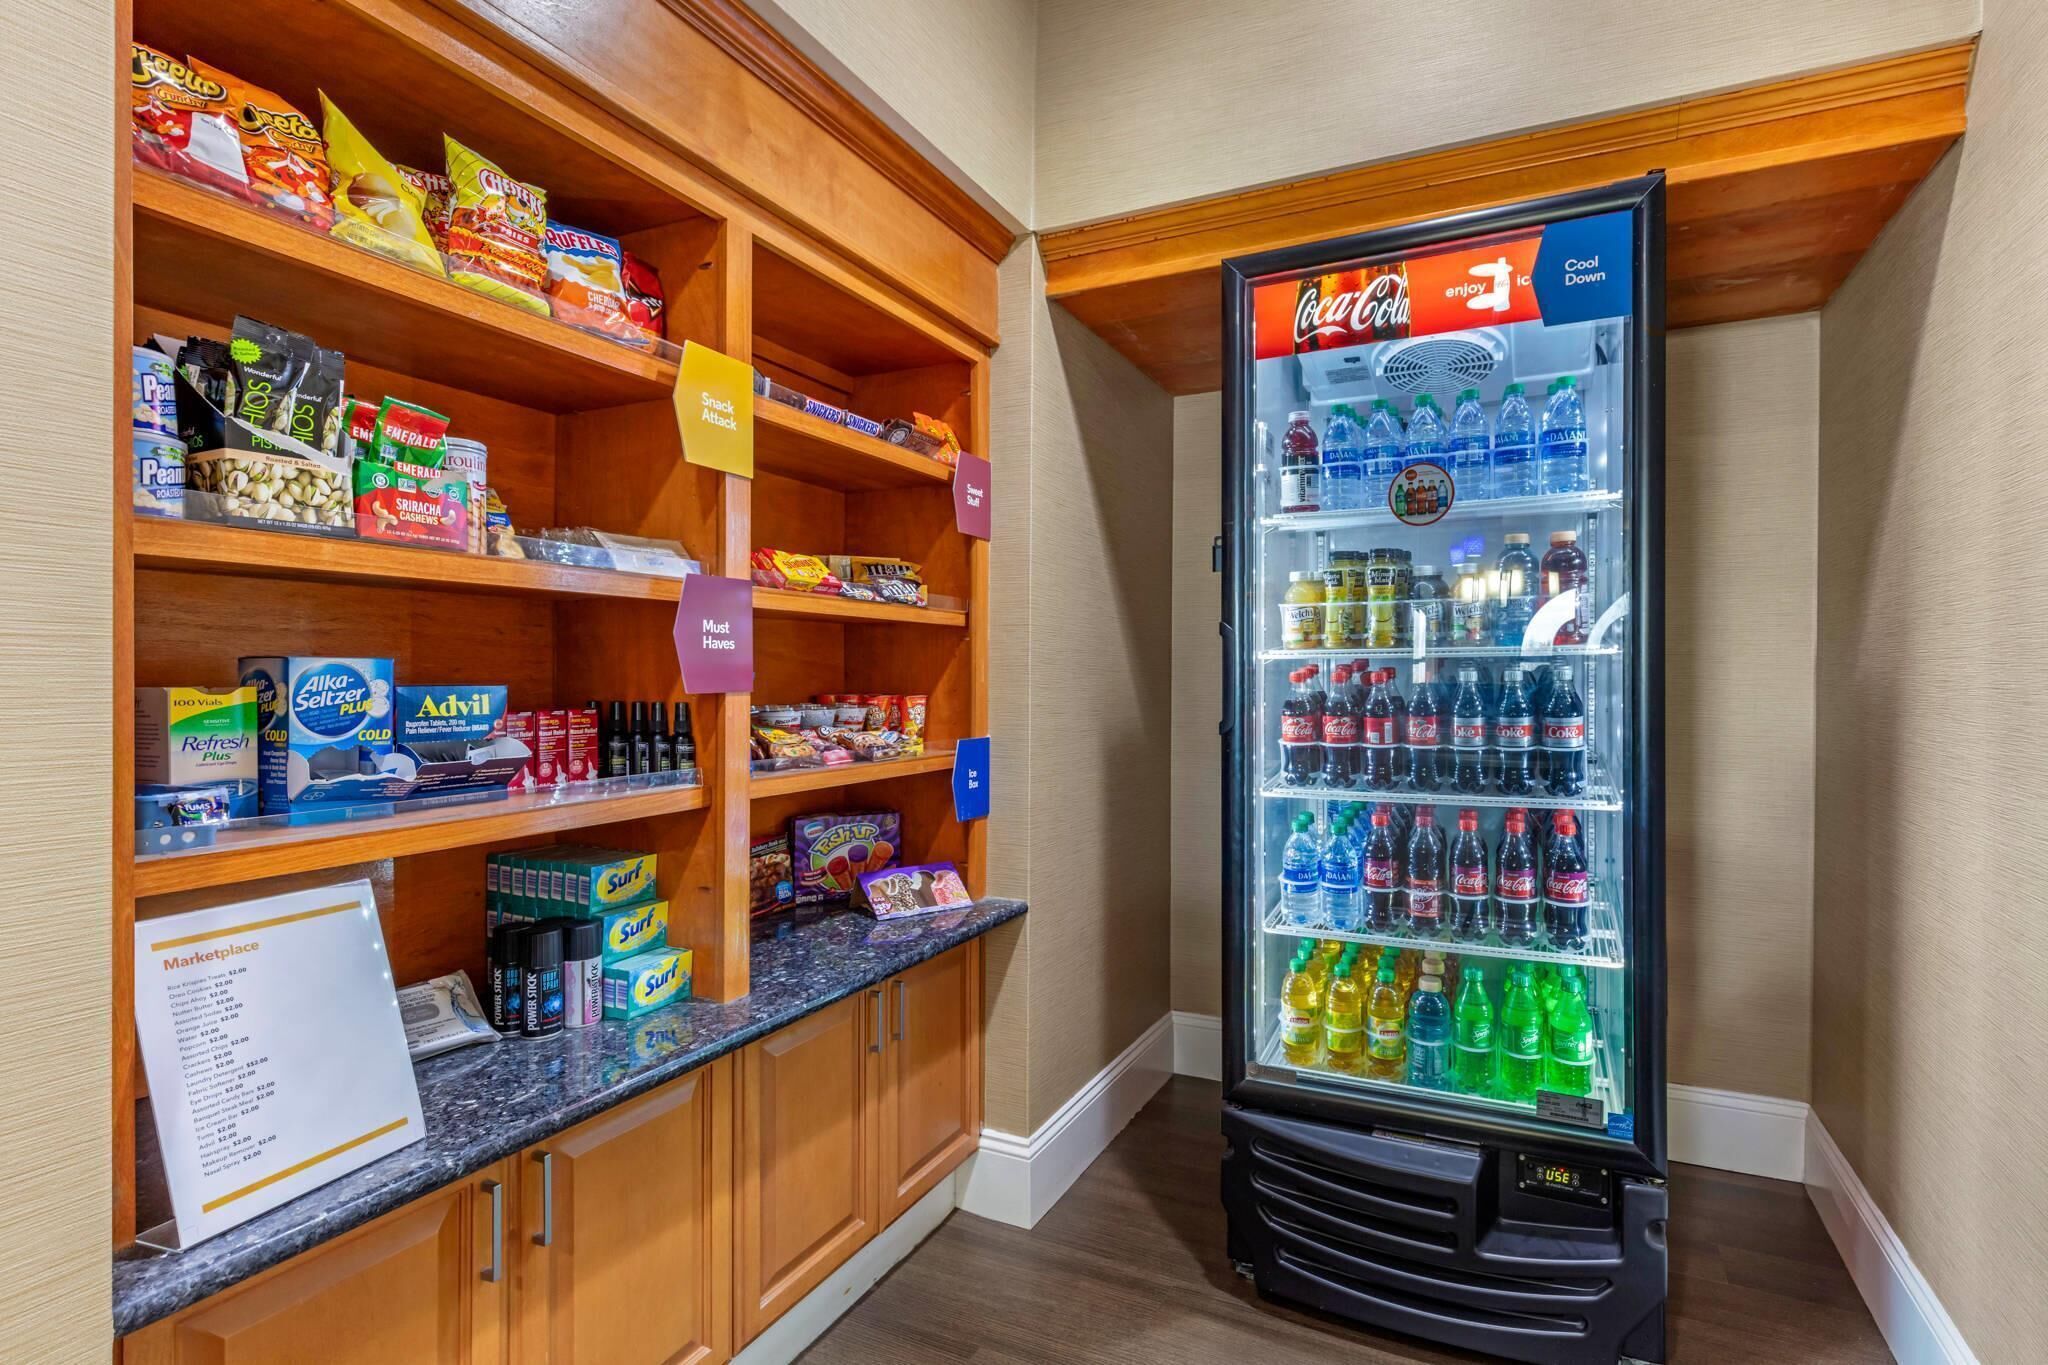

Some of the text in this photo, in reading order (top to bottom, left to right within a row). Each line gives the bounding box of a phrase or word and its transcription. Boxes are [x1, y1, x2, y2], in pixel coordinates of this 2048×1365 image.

[545, 227, 619, 259] RUFFLES
[1565, 256, 1599, 272] Cool
[1564, 270, 1606, 286] Down
[1445, 281, 1486, 298] enjoy
[1293, 273, 1411, 344] Coca-Cola
[243, 366, 282, 381] Wonderful
[702, 392, 734, 414] Snack
[805, 400, 841, 423] SNICKERS
[702, 408, 737, 431] Attack
[847, 414, 879, 436] SNICKERS
[385, 424, 439, 450] EMERALD
[265, 455, 293, 465] Roasted
[301, 461, 321, 469] Salted
[396, 462, 441, 480] EMERALD
[967, 483, 983, 498] Sweet
[396, 497, 441, 517] SRIRACHA
[967, 494, 980, 508] Stuff
[399, 510, 439, 526] CASHEWS
[703, 619, 730, 634] Must
[703, 635, 735, 650] Haves
[300, 674, 355, 694] Alka-
[174, 698, 223, 707] 100 Vials
[295, 687, 366, 711] Seltzer
[340, 698, 373, 715] PLUS
[415, 693, 490, 718] Advil
[405, 720, 429, 728] Ibuprofen
[405, 727, 417, 735] Pain
[1496, 725, 1524, 738] Coke
[1549, 725, 1579, 738] Coke
[182, 733, 249, 752] Refresh
[264, 730, 288, 742] COLD
[358, 729, 392, 741] COLD
[202, 751, 232, 761] Plus
[968, 779, 979, 789] Box
[184, 802, 211, 811] TUMS
[607, 859, 644, 894] Surf
[619, 907, 656, 944] Surf
[163, 942, 259, 971] Marketplace
[182, 978, 207, 987] Krispies
[229, 967, 247, 976] $2.00
[644, 958, 680, 998] Surf
[187, 986, 212, 995] Cookies
[215, 980, 233, 988] $2.00
[210, 990, 228, 998] $2.00
[494, 967, 504, 1026] POWER STICK
[172, 997, 234, 1017] Nutter Butter $2.00
[527, 972, 540, 1031] POWER STICK
[592, 988, 600, 1018] POWER
[175, 1003, 243, 1026] Assorted Sodas $2.00
[176, 1025, 200, 1035] Orange
[221, 1013, 238, 1022] $2.00
[177, 1028, 219, 1043] Water $2.00
[180, 1034, 228, 1052] Popcorn $2.00
[182, 1037, 249, 1061] Assorted Chips $2.00
[183, 1051, 232, 1069] Crackers $2.00
[185, 1059, 234, 1079] Cashews $2.00
[187, 1077, 212, 1088] Laundry
[213, 1065, 243, 1079] Detergent
[189, 1070, 255, 1096] Fabric Softener $2.00
[190, 1083, 243, 1106] Eye Drops $2.00
[192, 1082, 275, 1114] Assorted Candy Bars $2.00
[194, 1090, 274, 1123] Banquet Steak Meal $2.00
[206, 1118, 226, 1128] Cream
[241, 1105, 259, 1115] $2.00
[197, 1123, 236, 1140] Tums $2.00
[199, 1132, 237, 1150] Advil $2.00
[201, 1136, 251, 1159] Hairspray $2.00
[202, 1135, 276, 1168] Makeup Remover $2.00
[204, 1151, 261, 1177] Nasal Spray $2.00
[1546, 1169, 1570, 1184] USE
